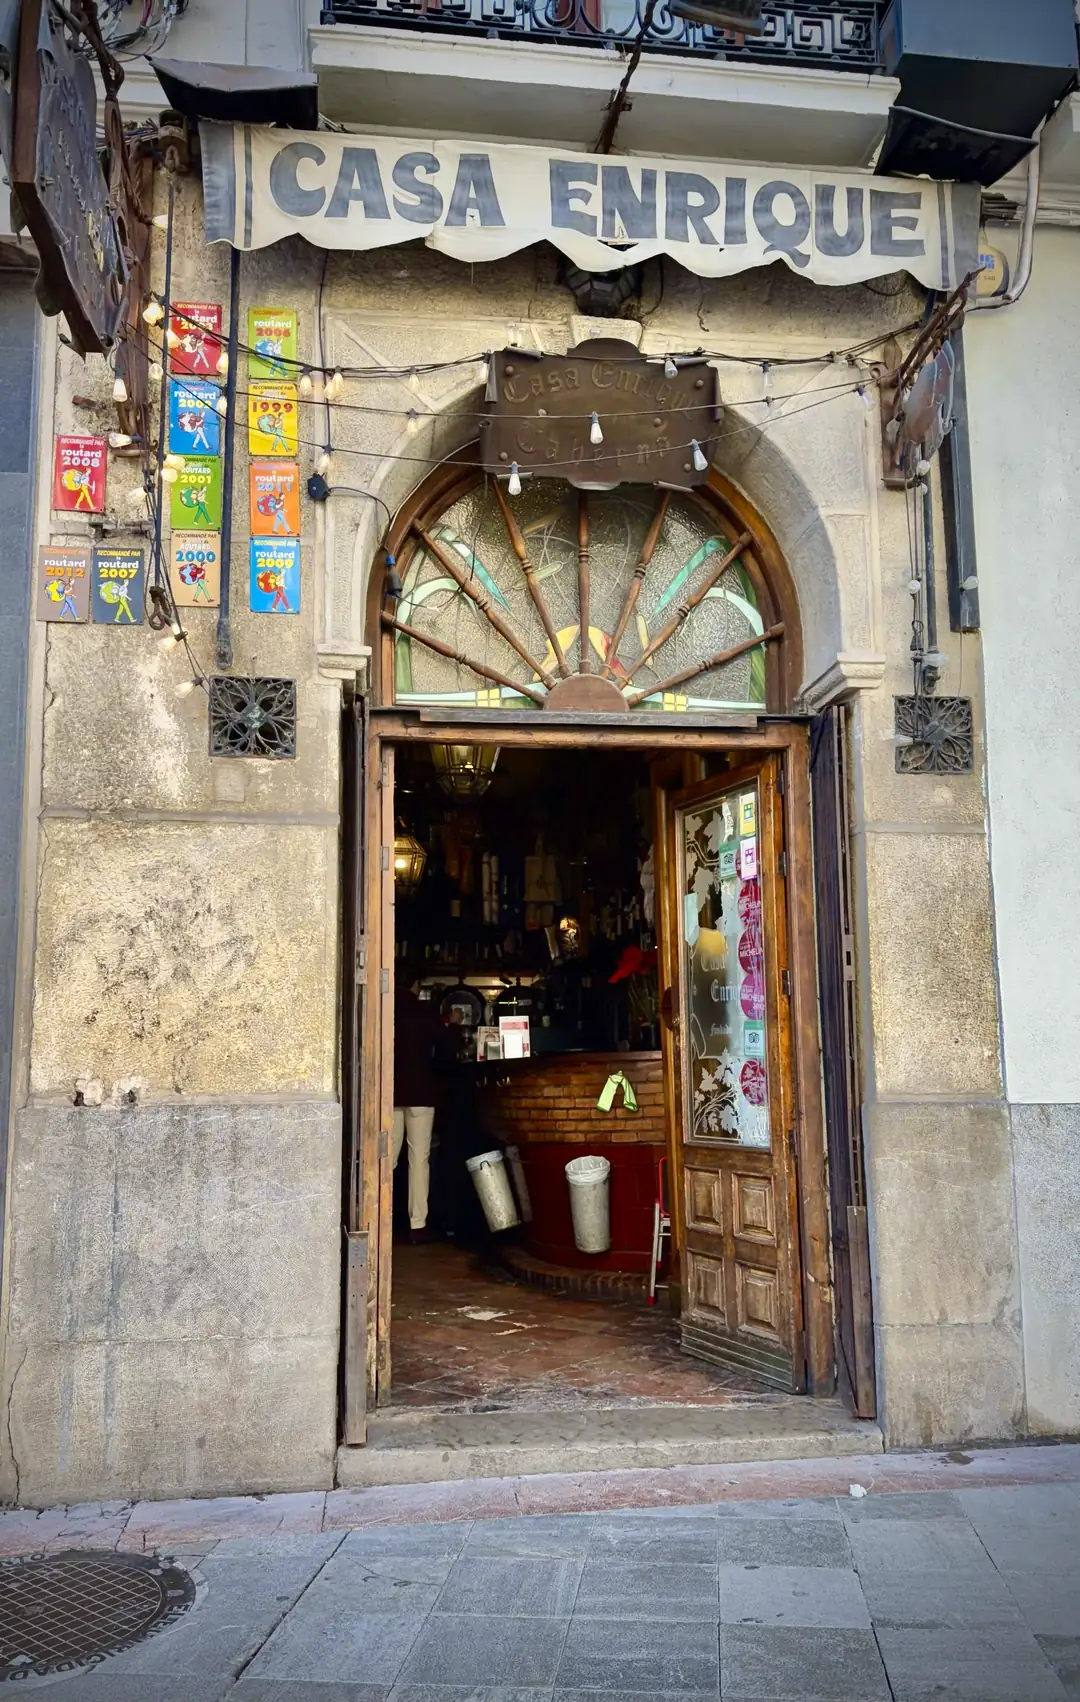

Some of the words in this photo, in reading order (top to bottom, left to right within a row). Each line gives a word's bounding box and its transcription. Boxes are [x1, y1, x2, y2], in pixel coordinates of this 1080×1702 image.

[270, 142, 506, 227] CASA
[549, 159, 926, 268] ENRIQUE
[253, 320, 292, 328] routard
[256, 327, 292, 337] 2006
[503, 367, 581, 404] Casa
[174, 390, 216, 399] routard
[253, 401, 293, 413] 1999
[61, 449, 102, 458] routard
[63, 456, 100, 467] 2008
[180, 474, 212, 484] 2001
[255, 473, 295, 483] routard
[175, 550, 216, 563] 2000
[255, 550, 295, 559] routard
[44, 559, 86, 568] routard
[98, 560, 139, 569] routard
[256, 557, 294, 569] 2009
[45, 566, 85, 578] 2012
[99, 568, 138, 579] 2007
